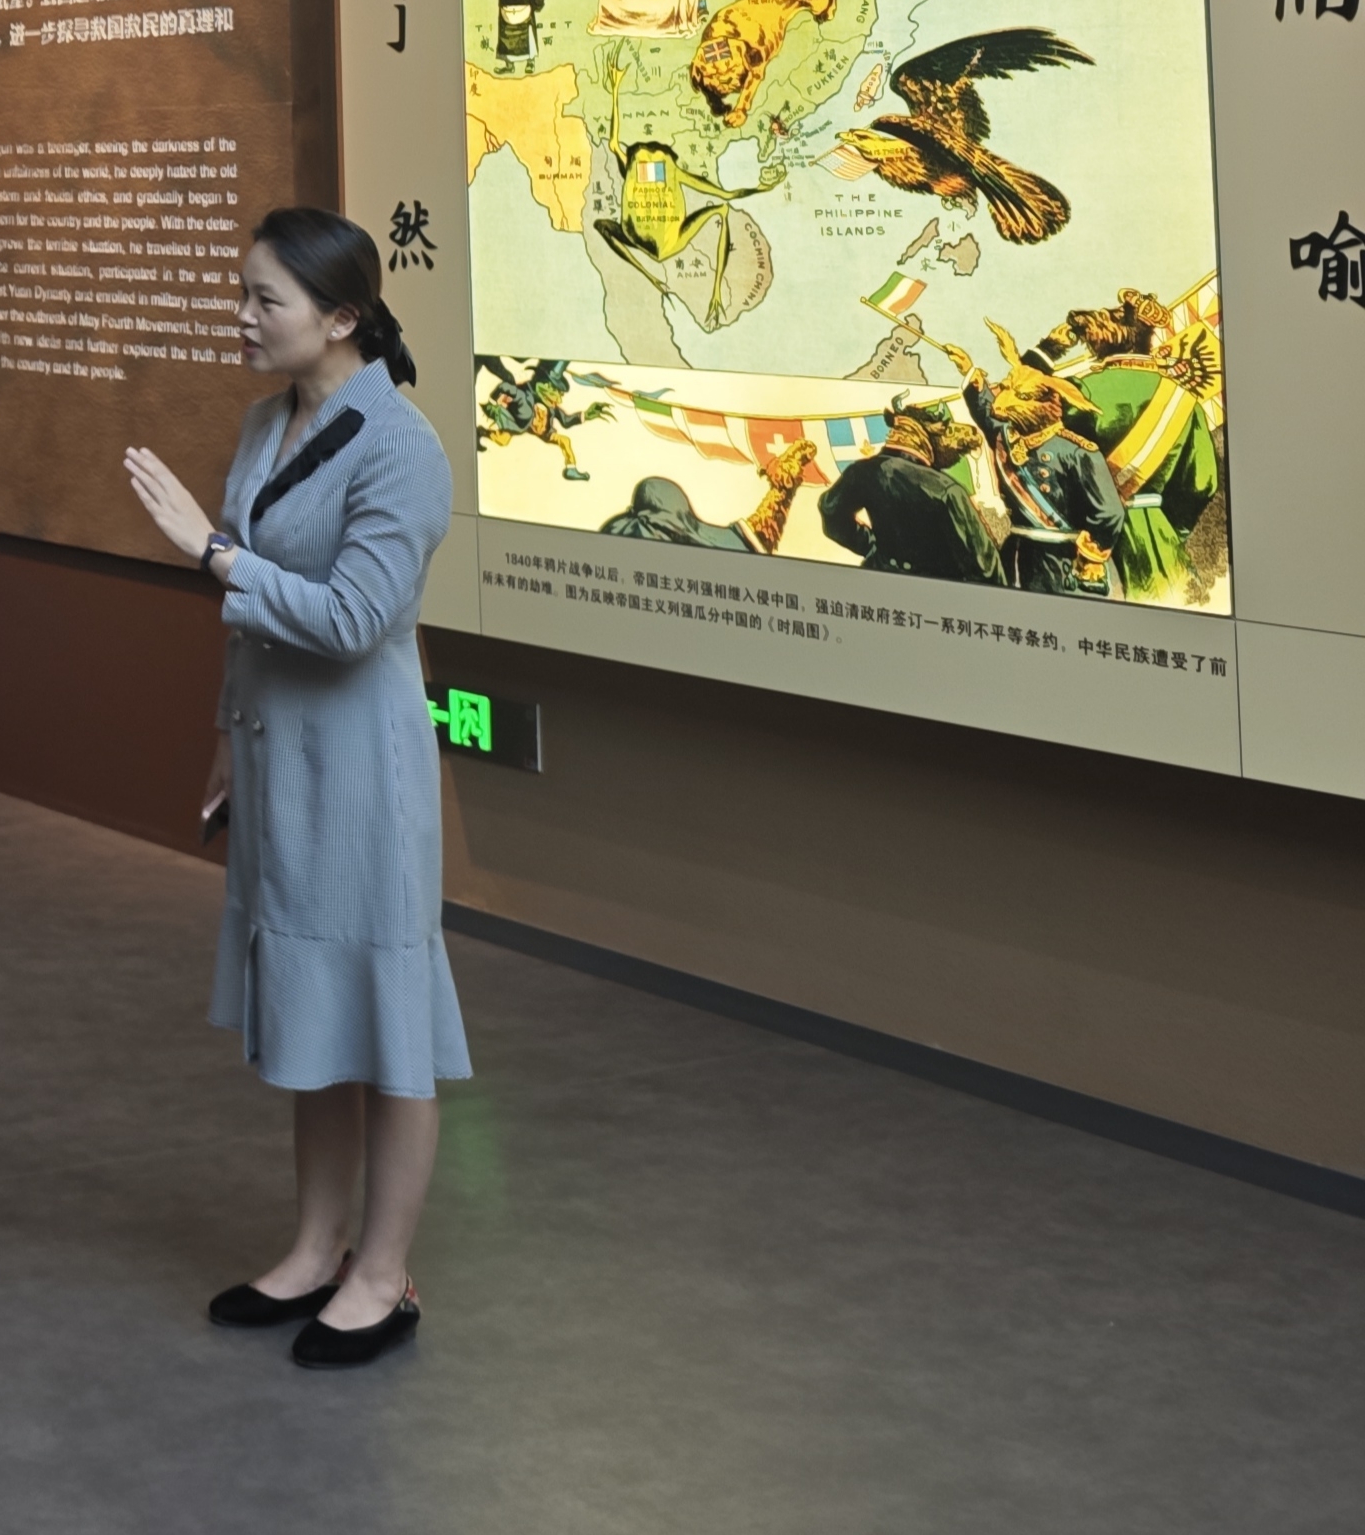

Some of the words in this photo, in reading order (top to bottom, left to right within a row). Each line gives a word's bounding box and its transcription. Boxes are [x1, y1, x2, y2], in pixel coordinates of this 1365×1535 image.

[806, 55, 850, 95] FUKKIEN
[95, 139, 128, 156] seeing
[132, 140, 148, 153] the
[152, 139, 200, 153] darkness
[204, 136, 215, 152] of
[219, 137, 237, 152] the
[114, 165, 127, 179] he
[130, 165, 164, 181] deeply
[167, 165, 197, 179] hated
[200, 165, 217, 179] the
[220, 164, 238, 179] old
[113, 191, 132, 204] and
[136, 190, 183, 207] gradually
[188, 191, 222, 208] began
[226, 191, 238, 205] to
[834, 193, 877, 203] THE
[814, 208, 904, 219] PHILIPPINE
[83, 215, 102, 228] and
[104, 215, 119, 229] the
[121, 215, 159, 232] people.
[161, 215, 184, 230] With
[187, 215, 204, 230] the
[820, 226, 886, 237] ISLANDS
[129, 240, 143, 254] he
[195, 242, 206, 257] to
[209, 242, 239, 258] know
[744, 221, 765, 270] COCHIN
[98, 266, 157, 282] participated
[162, 267, 173, 281] in
[178, 268, 196, 282] the
[201, 271, 222, 284] war
[228, 270, 240, 285] to
[743, 271, 766, 307] CHINA
[138, 292, 148, 305] in
[150, 292, 188, 311] military
[191, 296, 240, 314] academy
[101, 314, 134, 330] Fourth
[135, 316, 193, 336] Movement,
[195, 320, 209, 335] he
[210, 325, 241, 338] came
[122, 343, 167, 359] explored
[171, 346, 188, 360] the
[191, 347, 216, 362] truth
[220, 350, 242, 365] and
[870, 336, 904, 380] BORNEO
